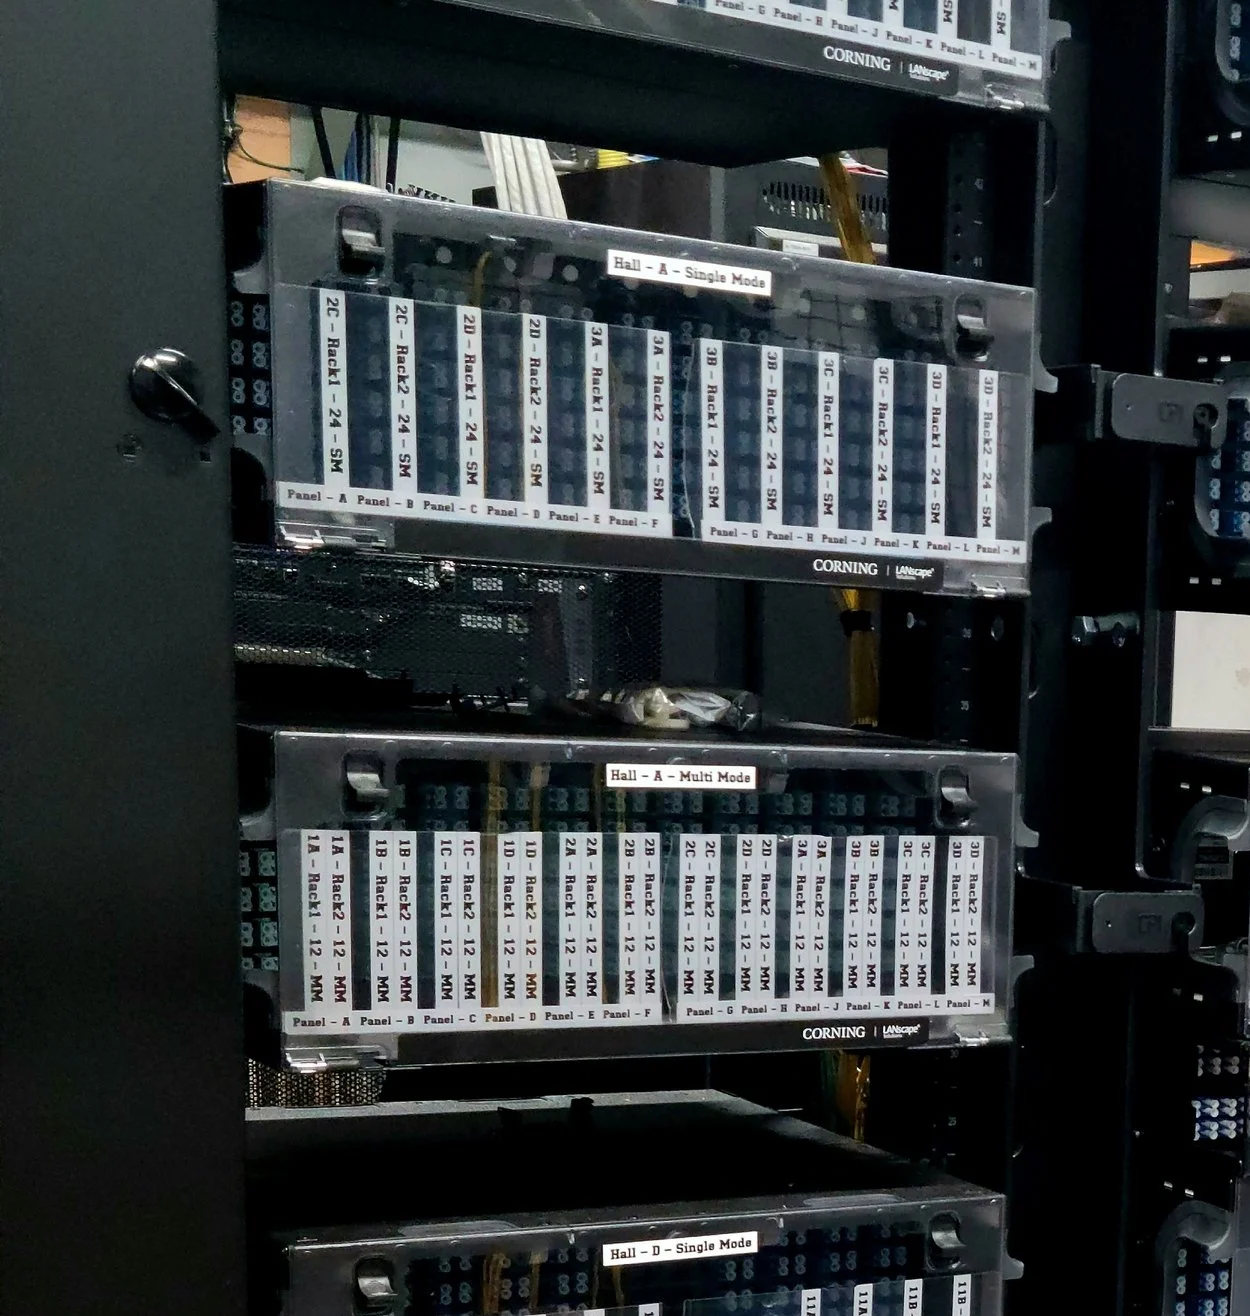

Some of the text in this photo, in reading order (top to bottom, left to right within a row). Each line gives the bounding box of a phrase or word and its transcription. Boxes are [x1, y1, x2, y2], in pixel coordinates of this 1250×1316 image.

[885, 29, 933, 49] Panel K
[822, 45, 891, 71] CORNING
[613, 255, 765, 289] Hall A Single Mode
[325, 296, 343, 473] 2C Rack1 24 SM
[766, 351, 778, 510] 3B Rack2 24 SM
[287, 488, 347, 503] Panel A
[812, 558, 878, 575] CORNING
[610, 768, 751, 783] Hall A Multi Mode
[306, 834, 323, 1002] 1A Rack1 12 MM
[585, 837, 597, 997] 2A Rack2 12 MM
[966, 840, 980, 986] 3D Rack2 12 MM
[292, 1016, 350, 1027] Panel A
[802, 1025, 865, 1040] CORNING
[610, 1236, 752, 1260] Hall D Single Mode
